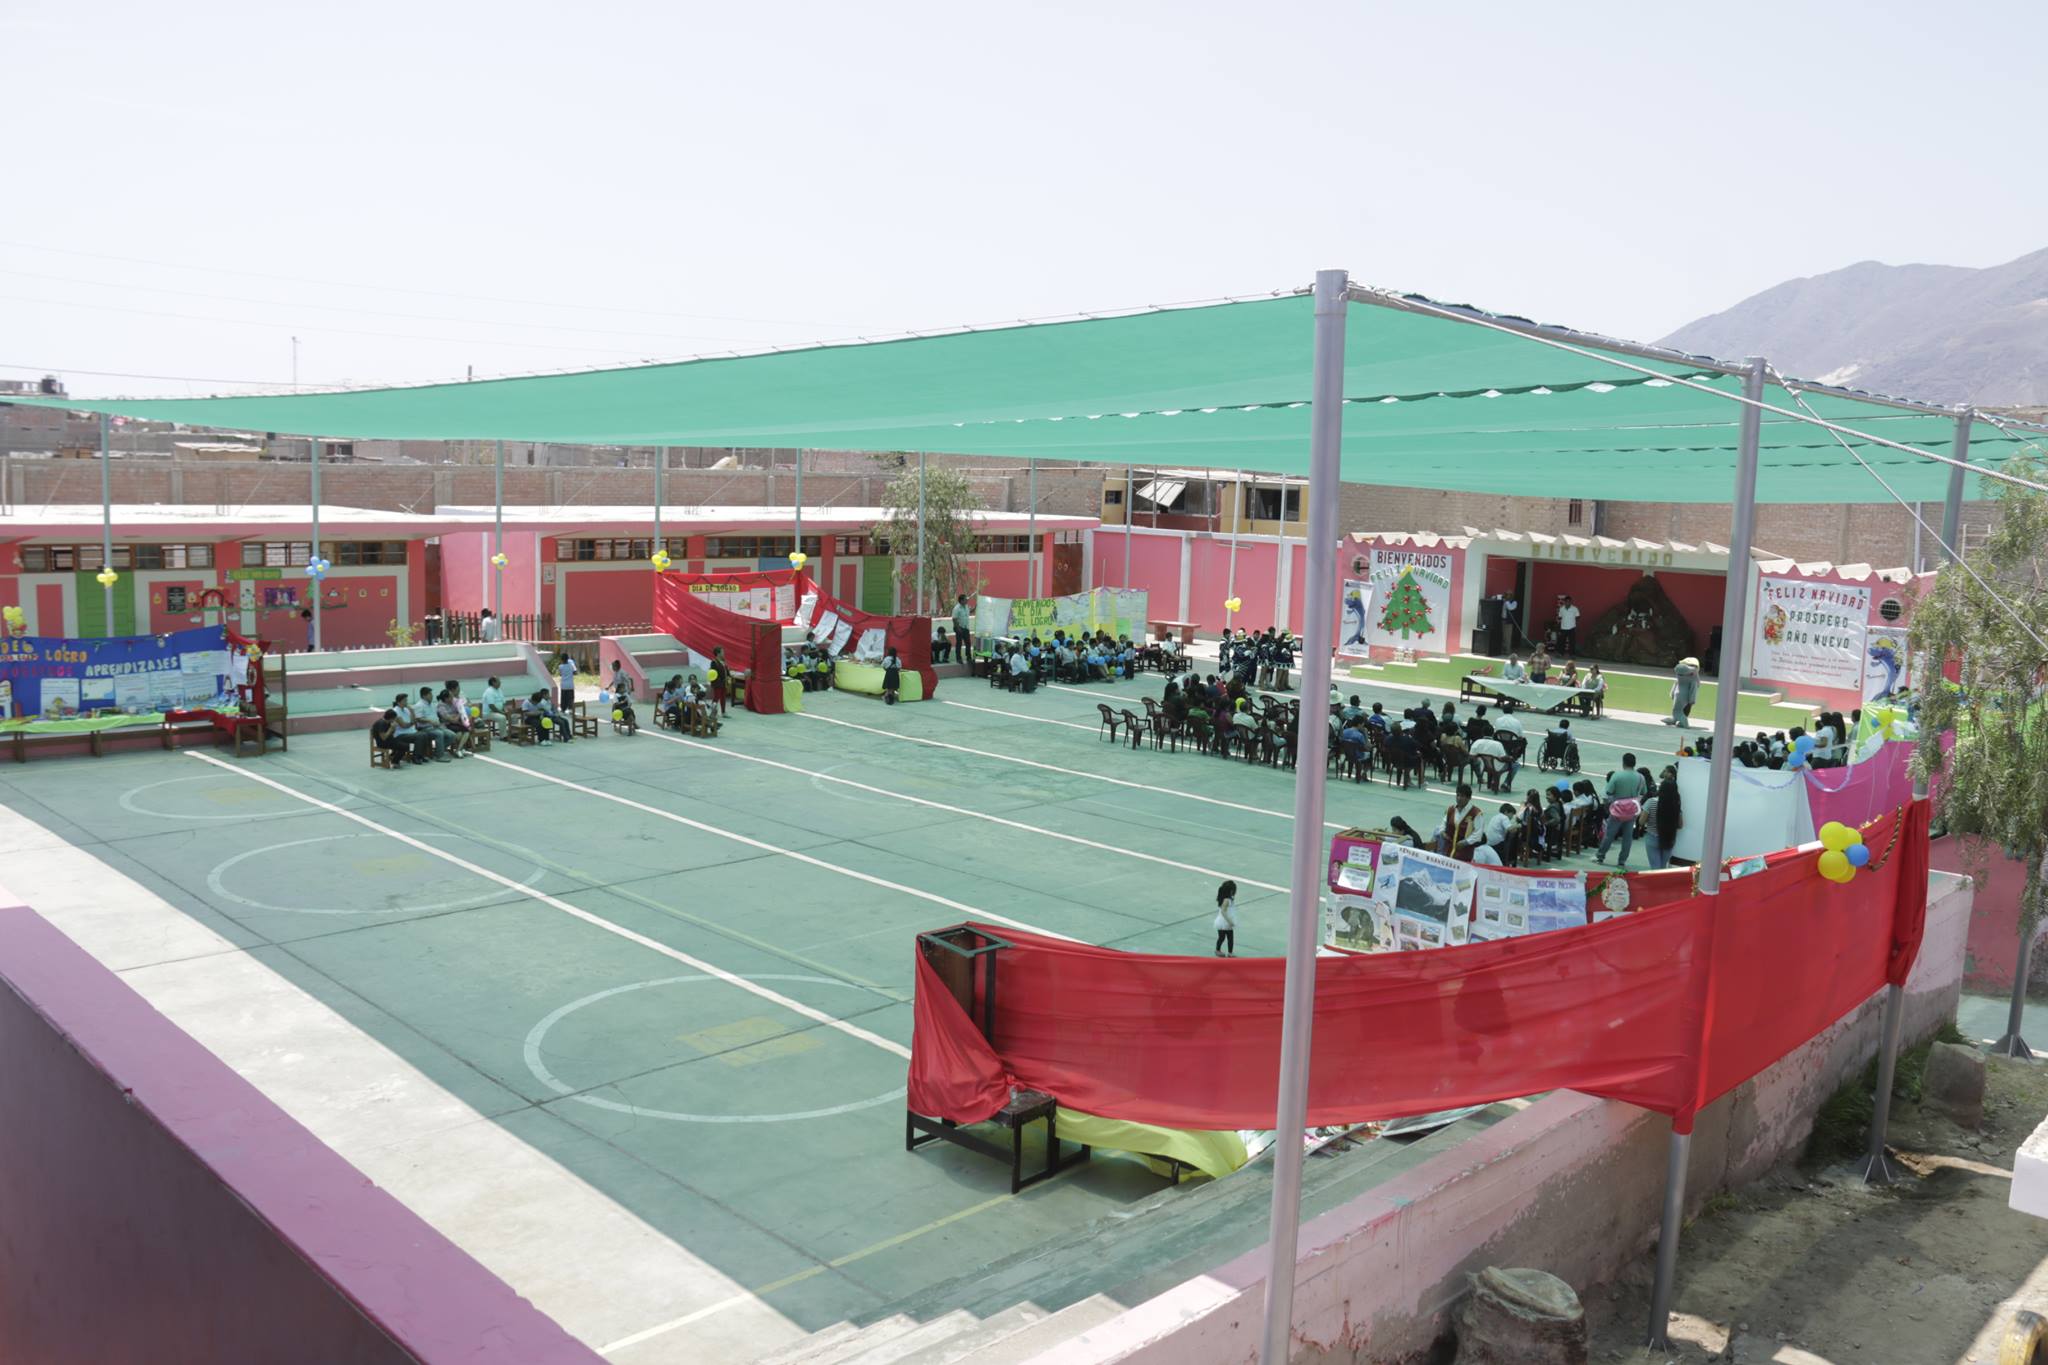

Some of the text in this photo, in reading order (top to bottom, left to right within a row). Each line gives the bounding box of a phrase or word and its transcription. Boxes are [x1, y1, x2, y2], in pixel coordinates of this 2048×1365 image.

[1377, 551, 1447, 569] BIENVENIDOS
[1532, 543, 1673, 565] BIENVENIDO
[1413, 568, 1449, 590] NAVIDAD
[1768, 587, 1865, 610] FELIZ NAVIDAD
[1786, 630, 1850, 649] AÑO NUEVO
[85, 656, 179, 677] APRENDIZAJES
